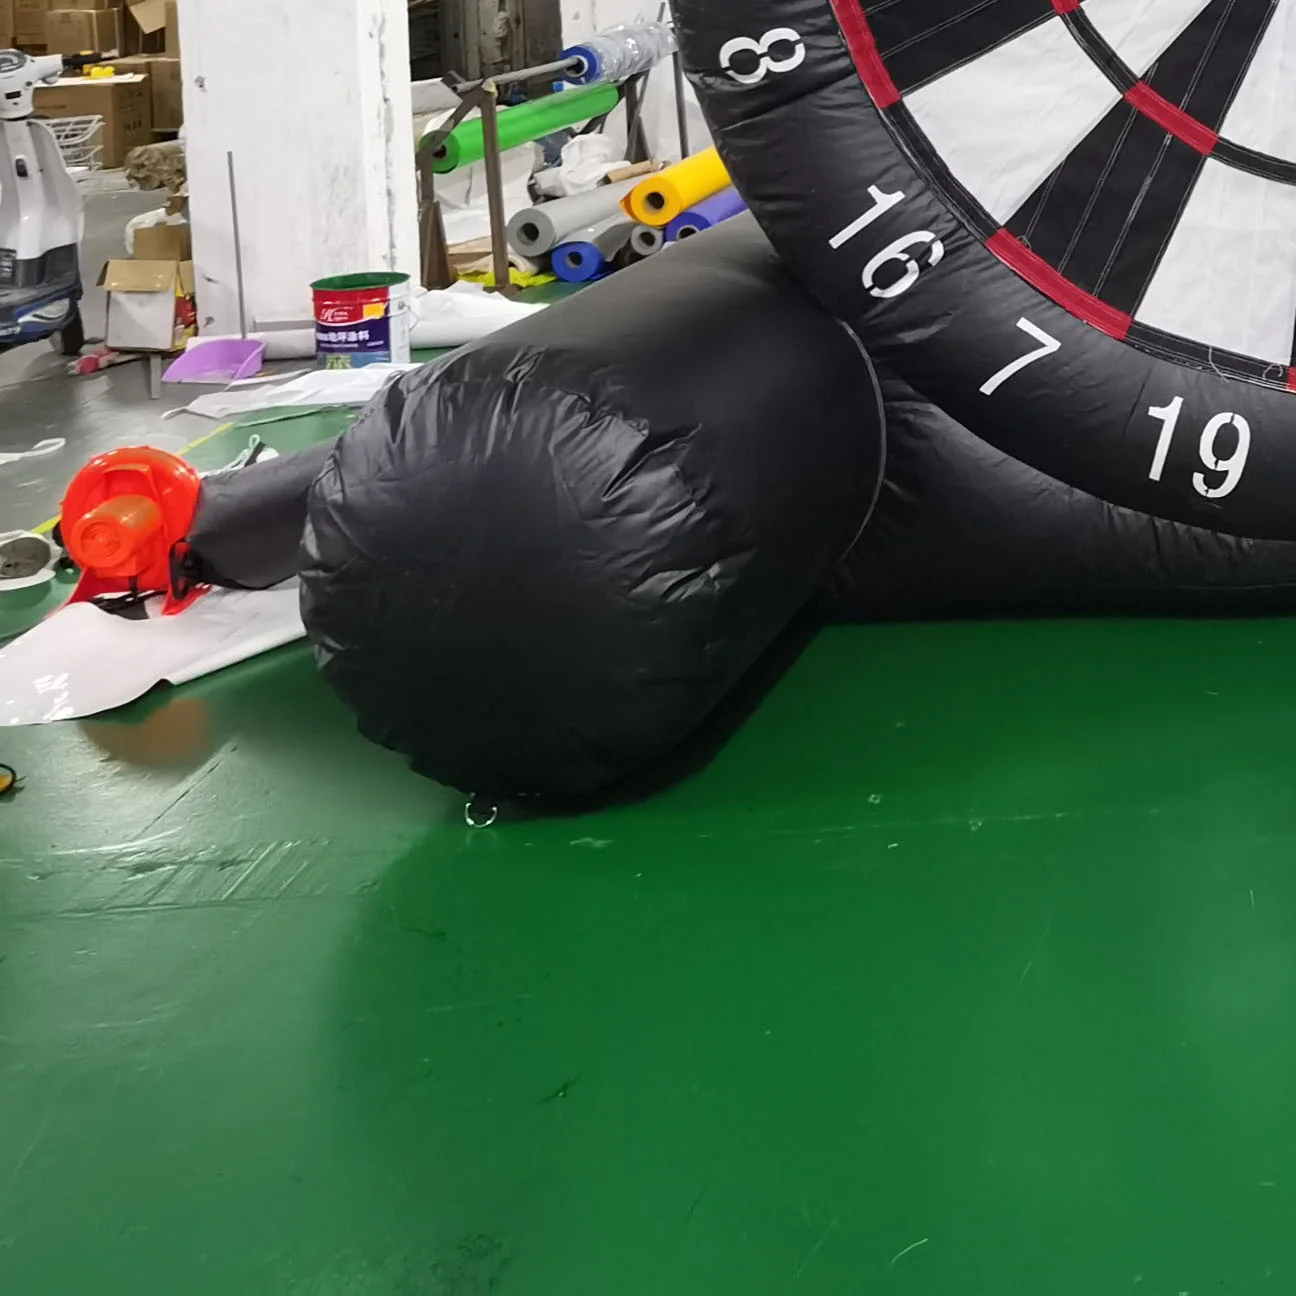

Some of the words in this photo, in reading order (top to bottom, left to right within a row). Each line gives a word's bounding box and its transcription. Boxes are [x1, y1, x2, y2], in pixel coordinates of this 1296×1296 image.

[719, 27, 806, 84] 8
[828, 184, 945, 298] 16
[979, 316, 1062, 396] 7
[1147, 395, 1251, 498] 19
